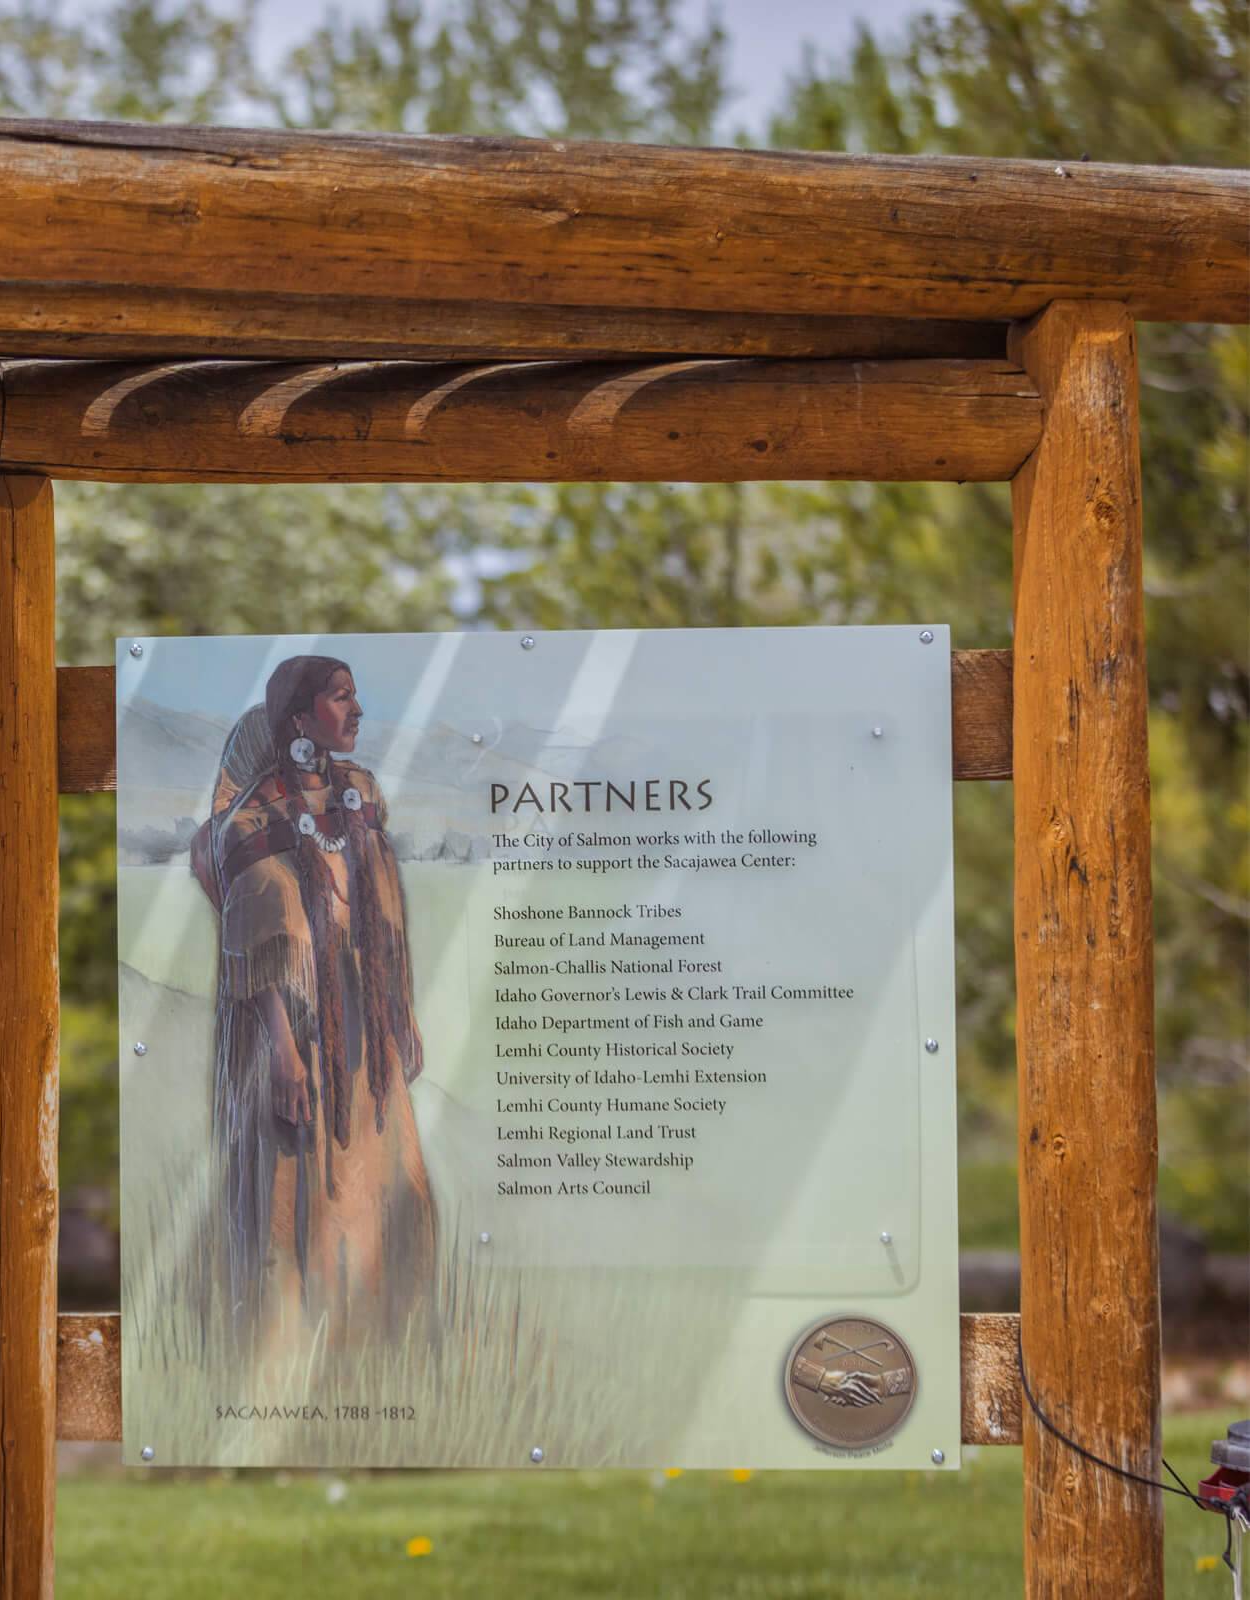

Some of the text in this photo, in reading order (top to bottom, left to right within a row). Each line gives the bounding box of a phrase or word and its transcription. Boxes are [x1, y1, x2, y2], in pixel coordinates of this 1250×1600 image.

[491, 779, 712, 813] PARTNERS
[491, 829, 817, 850] The City of Salmon works with the following
[493, 853, 795, 875] partners to support the Sacajawea Center:
[493, 903, 681, 920] Shoshone Bannock Tribes
[494, 931, 704, 950] Bureau of Land Management
[611, 958, 672, 973] National
[678, 959, 721, 973] Forest
[495, 987, 537, 1002] Idaho
[625, 987, 666, 1000] Lewis
[670, 987, 683, 1000] &
[687, 985, 728, 1000] Clark
[732, 985, 766, 1000] Trail
[770, 985, 854, 999] Committee
[495, 1013, 763, 1033] Idaho Department of Fish and Game
[496, 1041, 734, 1060] Lemhi County Historical Society
[496, 1071, 570, 1088] University
[574, 1069, 591, 1084] of
[694, 1069, 766, 1083] Extension
[497, 1096, 726, 1115] Lemhi County Humane Society
[497, 1124, 695, 1143] Lemhi Regional Land Trust
[497, 1151, 693, 1171] Salmon Valley Stewardship
[497, 1179, 650, 1195] Salmon Arts Council
[215, 1405, 328, 1421] SACAJAWEA,
[334, 1405, 369, 1420] 1788
